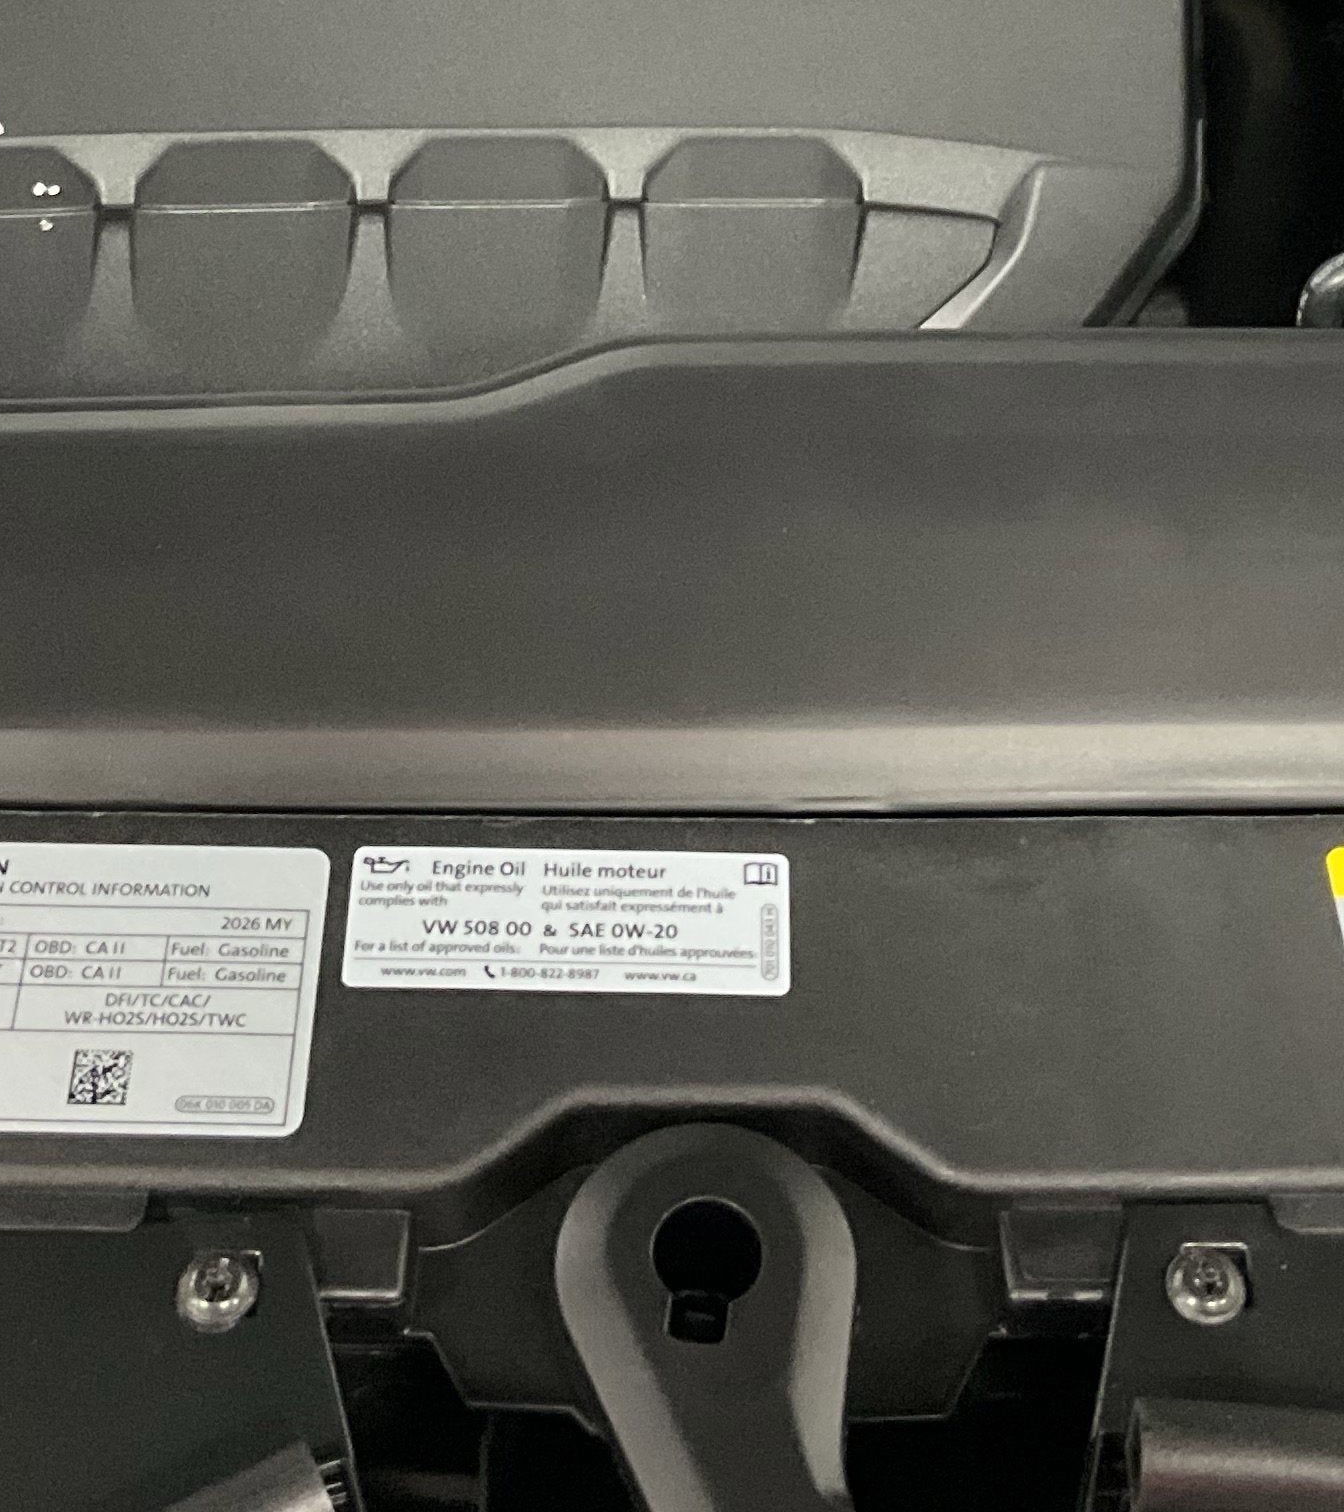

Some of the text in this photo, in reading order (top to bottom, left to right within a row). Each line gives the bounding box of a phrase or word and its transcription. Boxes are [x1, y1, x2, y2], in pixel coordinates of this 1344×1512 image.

[432, 860, 666, 879] Engine Oil Huile moteur
[9, 880, 87, 896] CONTROL
[92, 882, 211, 898] INFORMATION
[360, 880, 524, 896] Use only oil that expressly
[542, 885, 590, 897] Utilisez
[593, 886, 673, 900] uniquement
[677, 887, 693, 898] de
[358, 895, 448, 908] complies with
[541, 899, 562, 912] qui
[565, 900, 617, 912] satisfait
[221, 916, 261, 930] 2026
[265, 918, 293, 931] MY
[422, 919, 678, 939] VW 508 00 & SAE 0W-20
[218, 943, 289, 958] Gasoline
[355, 940, 376, 952] For
[389, 940, 409, 952] list
[412, 940, 427, 953] of
[428, 942, 490, 955] approved
[539, 943, 568, 955] Pour
[572, 945, 595, 956] une
[599, 944, 625, 956] liste
[214, 967, 287, 982] Gasoline
[381, 966, 466, 977] www.vw.com
[624, 970, 697, 982] www.vw.ca
